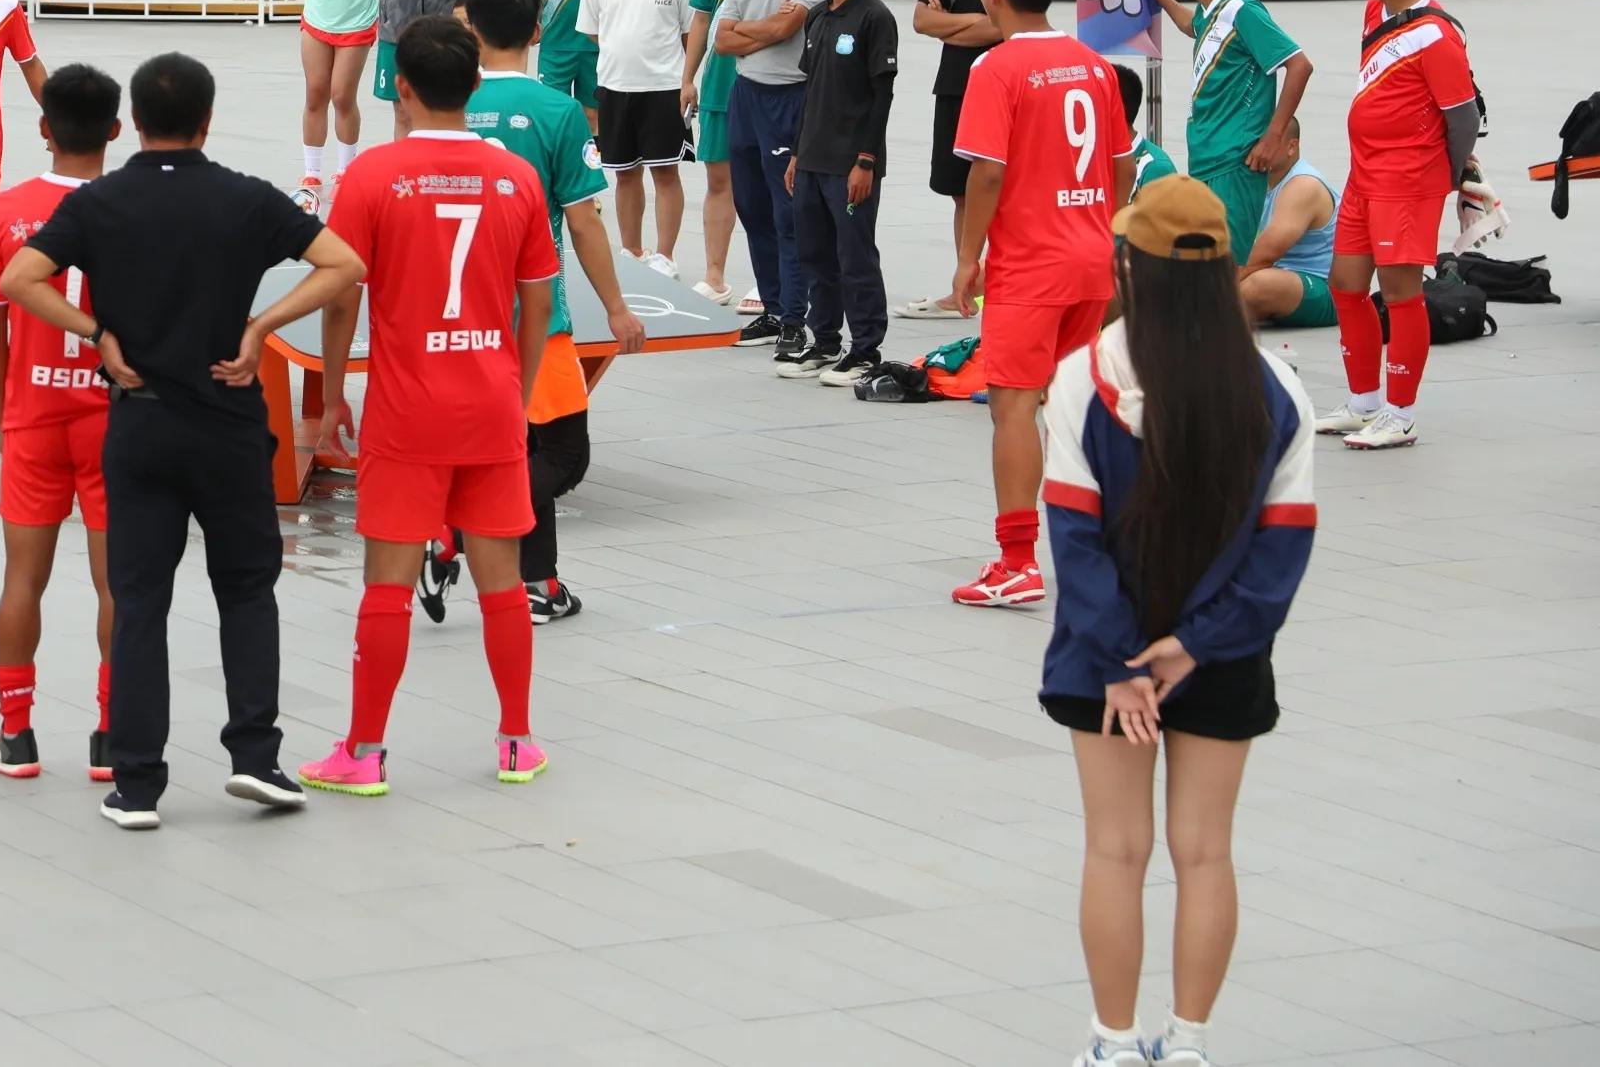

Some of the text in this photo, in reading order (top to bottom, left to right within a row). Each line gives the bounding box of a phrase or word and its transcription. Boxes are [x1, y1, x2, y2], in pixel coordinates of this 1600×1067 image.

[379, 69, 386, 89] 6
[1064, 88, 1096, 183] 9
[1057, 188, 1105, 207] BS04
[435, 203, 482, 319] 7
[426, 330, 501, 352] BS04
